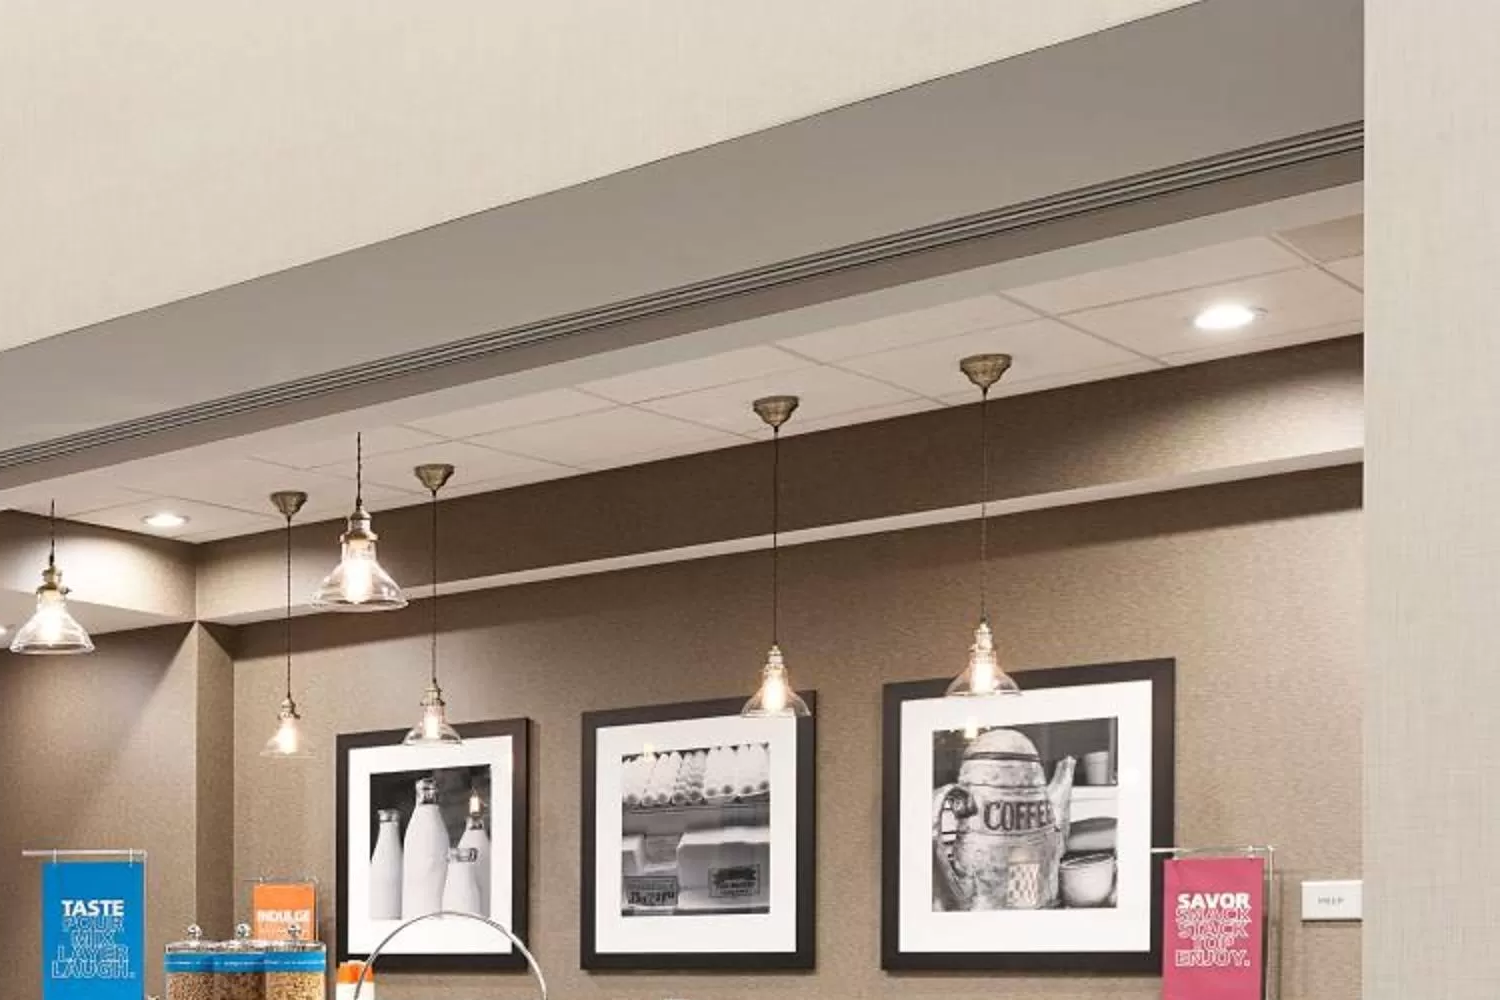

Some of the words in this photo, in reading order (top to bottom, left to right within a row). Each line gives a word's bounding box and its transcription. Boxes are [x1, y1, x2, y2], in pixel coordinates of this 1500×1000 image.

[983, 800, 1055, 831] COFFEE
[61, 899, 124, 917] TASTE
[1177, 893, 1250, 909] SAVOR
[1175, 949, 1251, 967] ENJOY.
[51, 960, 136, 979] LAUGH.
